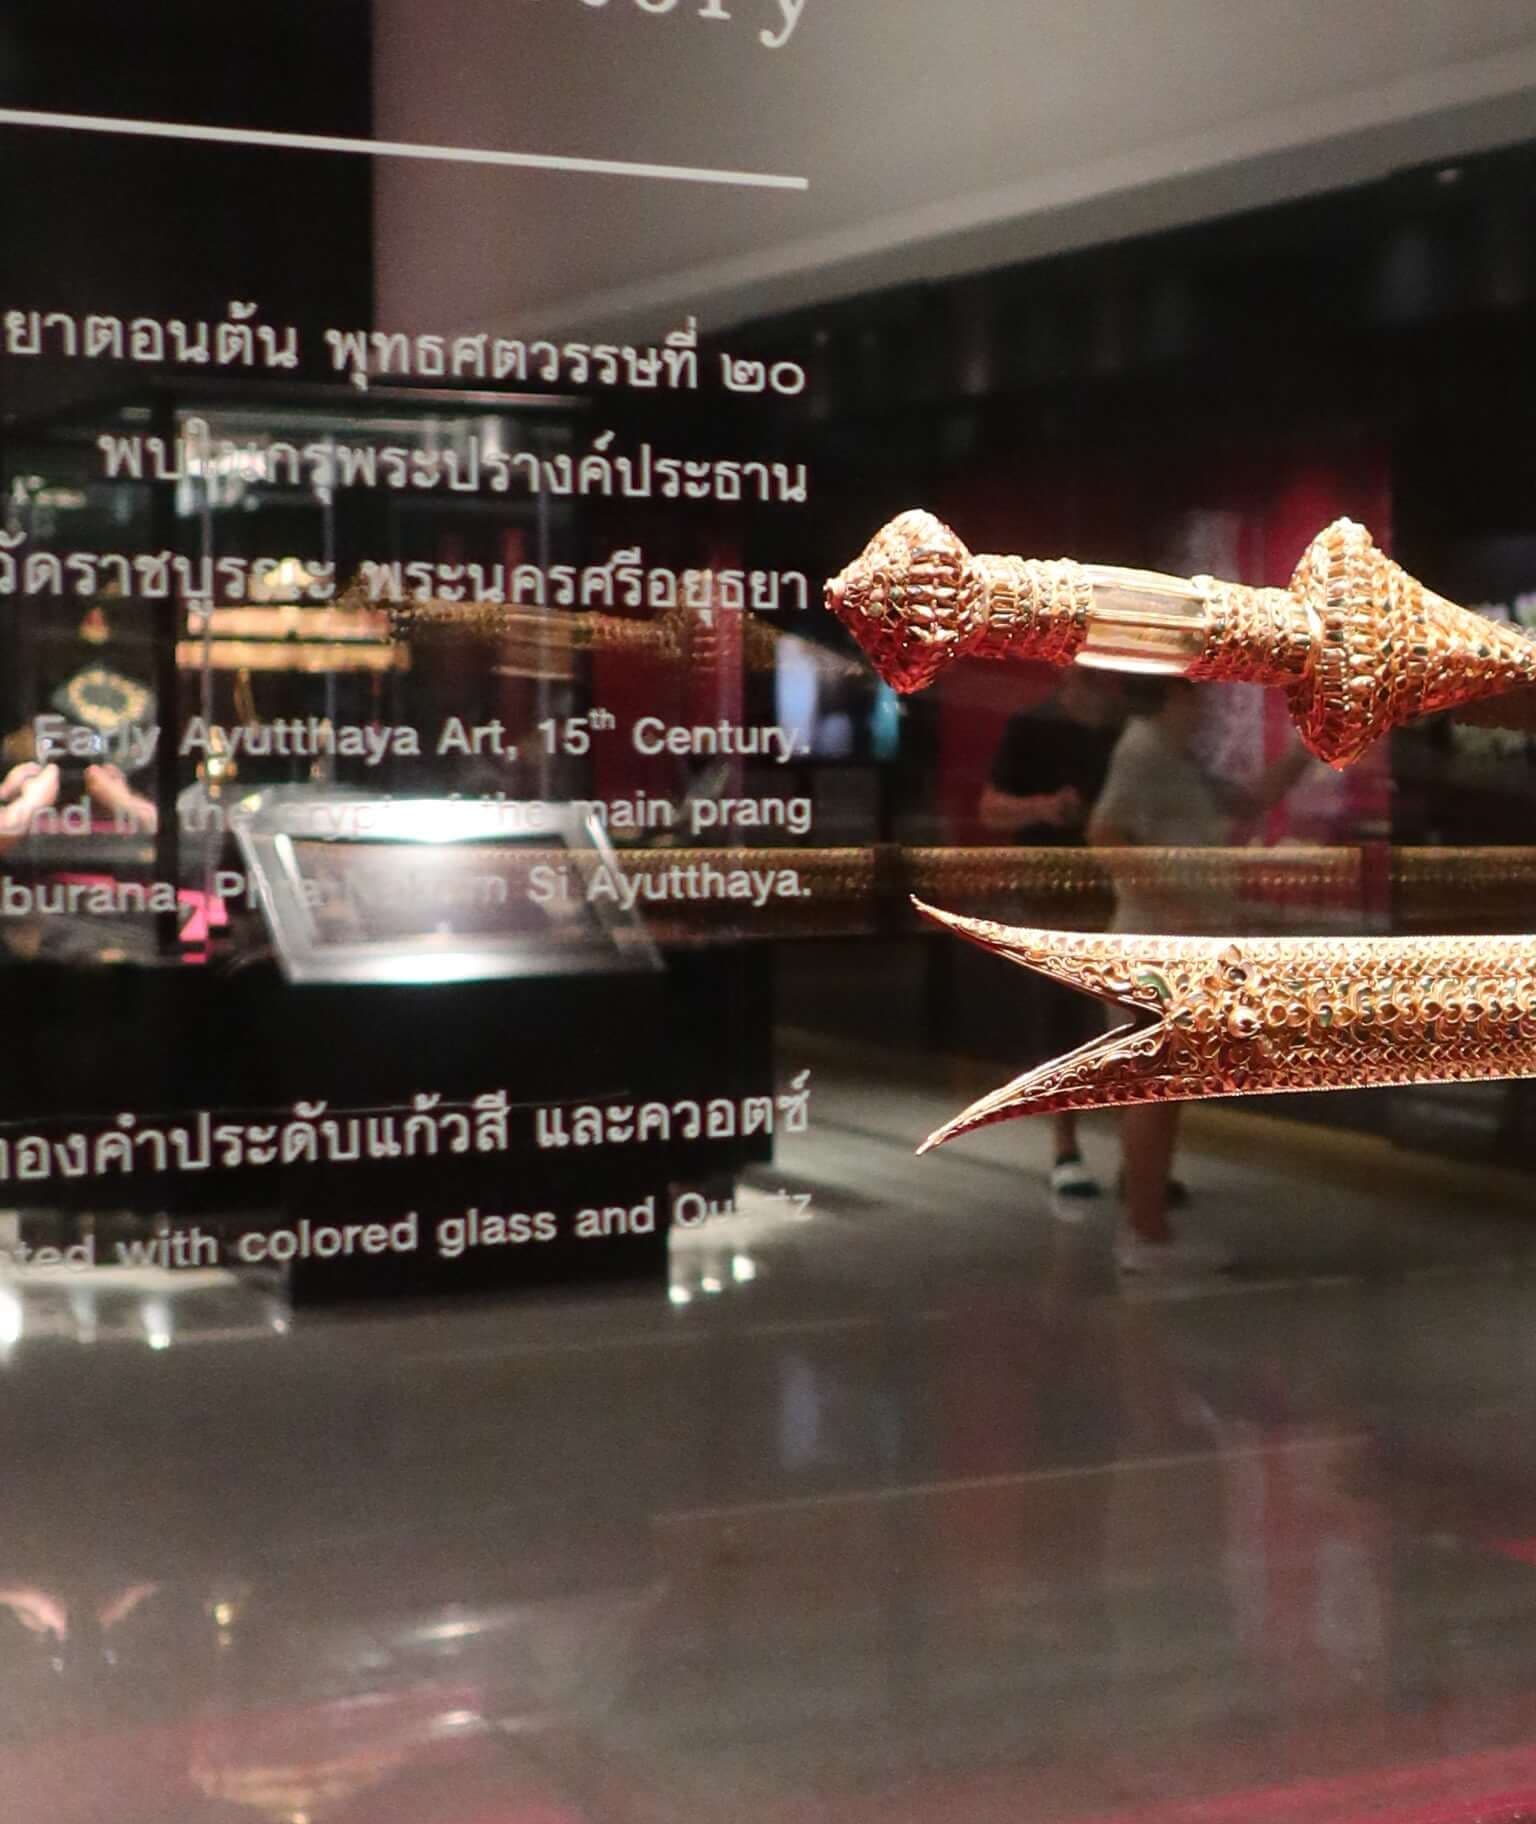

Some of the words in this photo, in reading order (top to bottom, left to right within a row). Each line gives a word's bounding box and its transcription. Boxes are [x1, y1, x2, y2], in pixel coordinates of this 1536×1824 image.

[3, 300, 299, 369] ยาตอนต้น
[322, 315, 699, 393] พุทธศตวรรษที่
[718, 352, 807, 396] ๒๐
[359, 546, 809, 629] พระนครศรีอยุธยา
[34, 714, 161, 770] Early
[178, 716, 421, 766] Ayutthaya
[436, 716, 518, 761] Art,
[538, 707, 616, 755] 15th
[632, 717, 812, 763] Century.
[570, 789, 673, 829] main
[689, 795, 813, 837] prang
[527, 862, 569, 904] Si
[586, 864, 813, 912] Ayutthaya.
[534, 1067, 812, 1149] และควอตซ์
[113, 1226, 219, 1269] with
[235, 1210, 419, 1264] colored
[437, 1206, 558, 1259] glass
[573, 1194, 656, 1239] and
